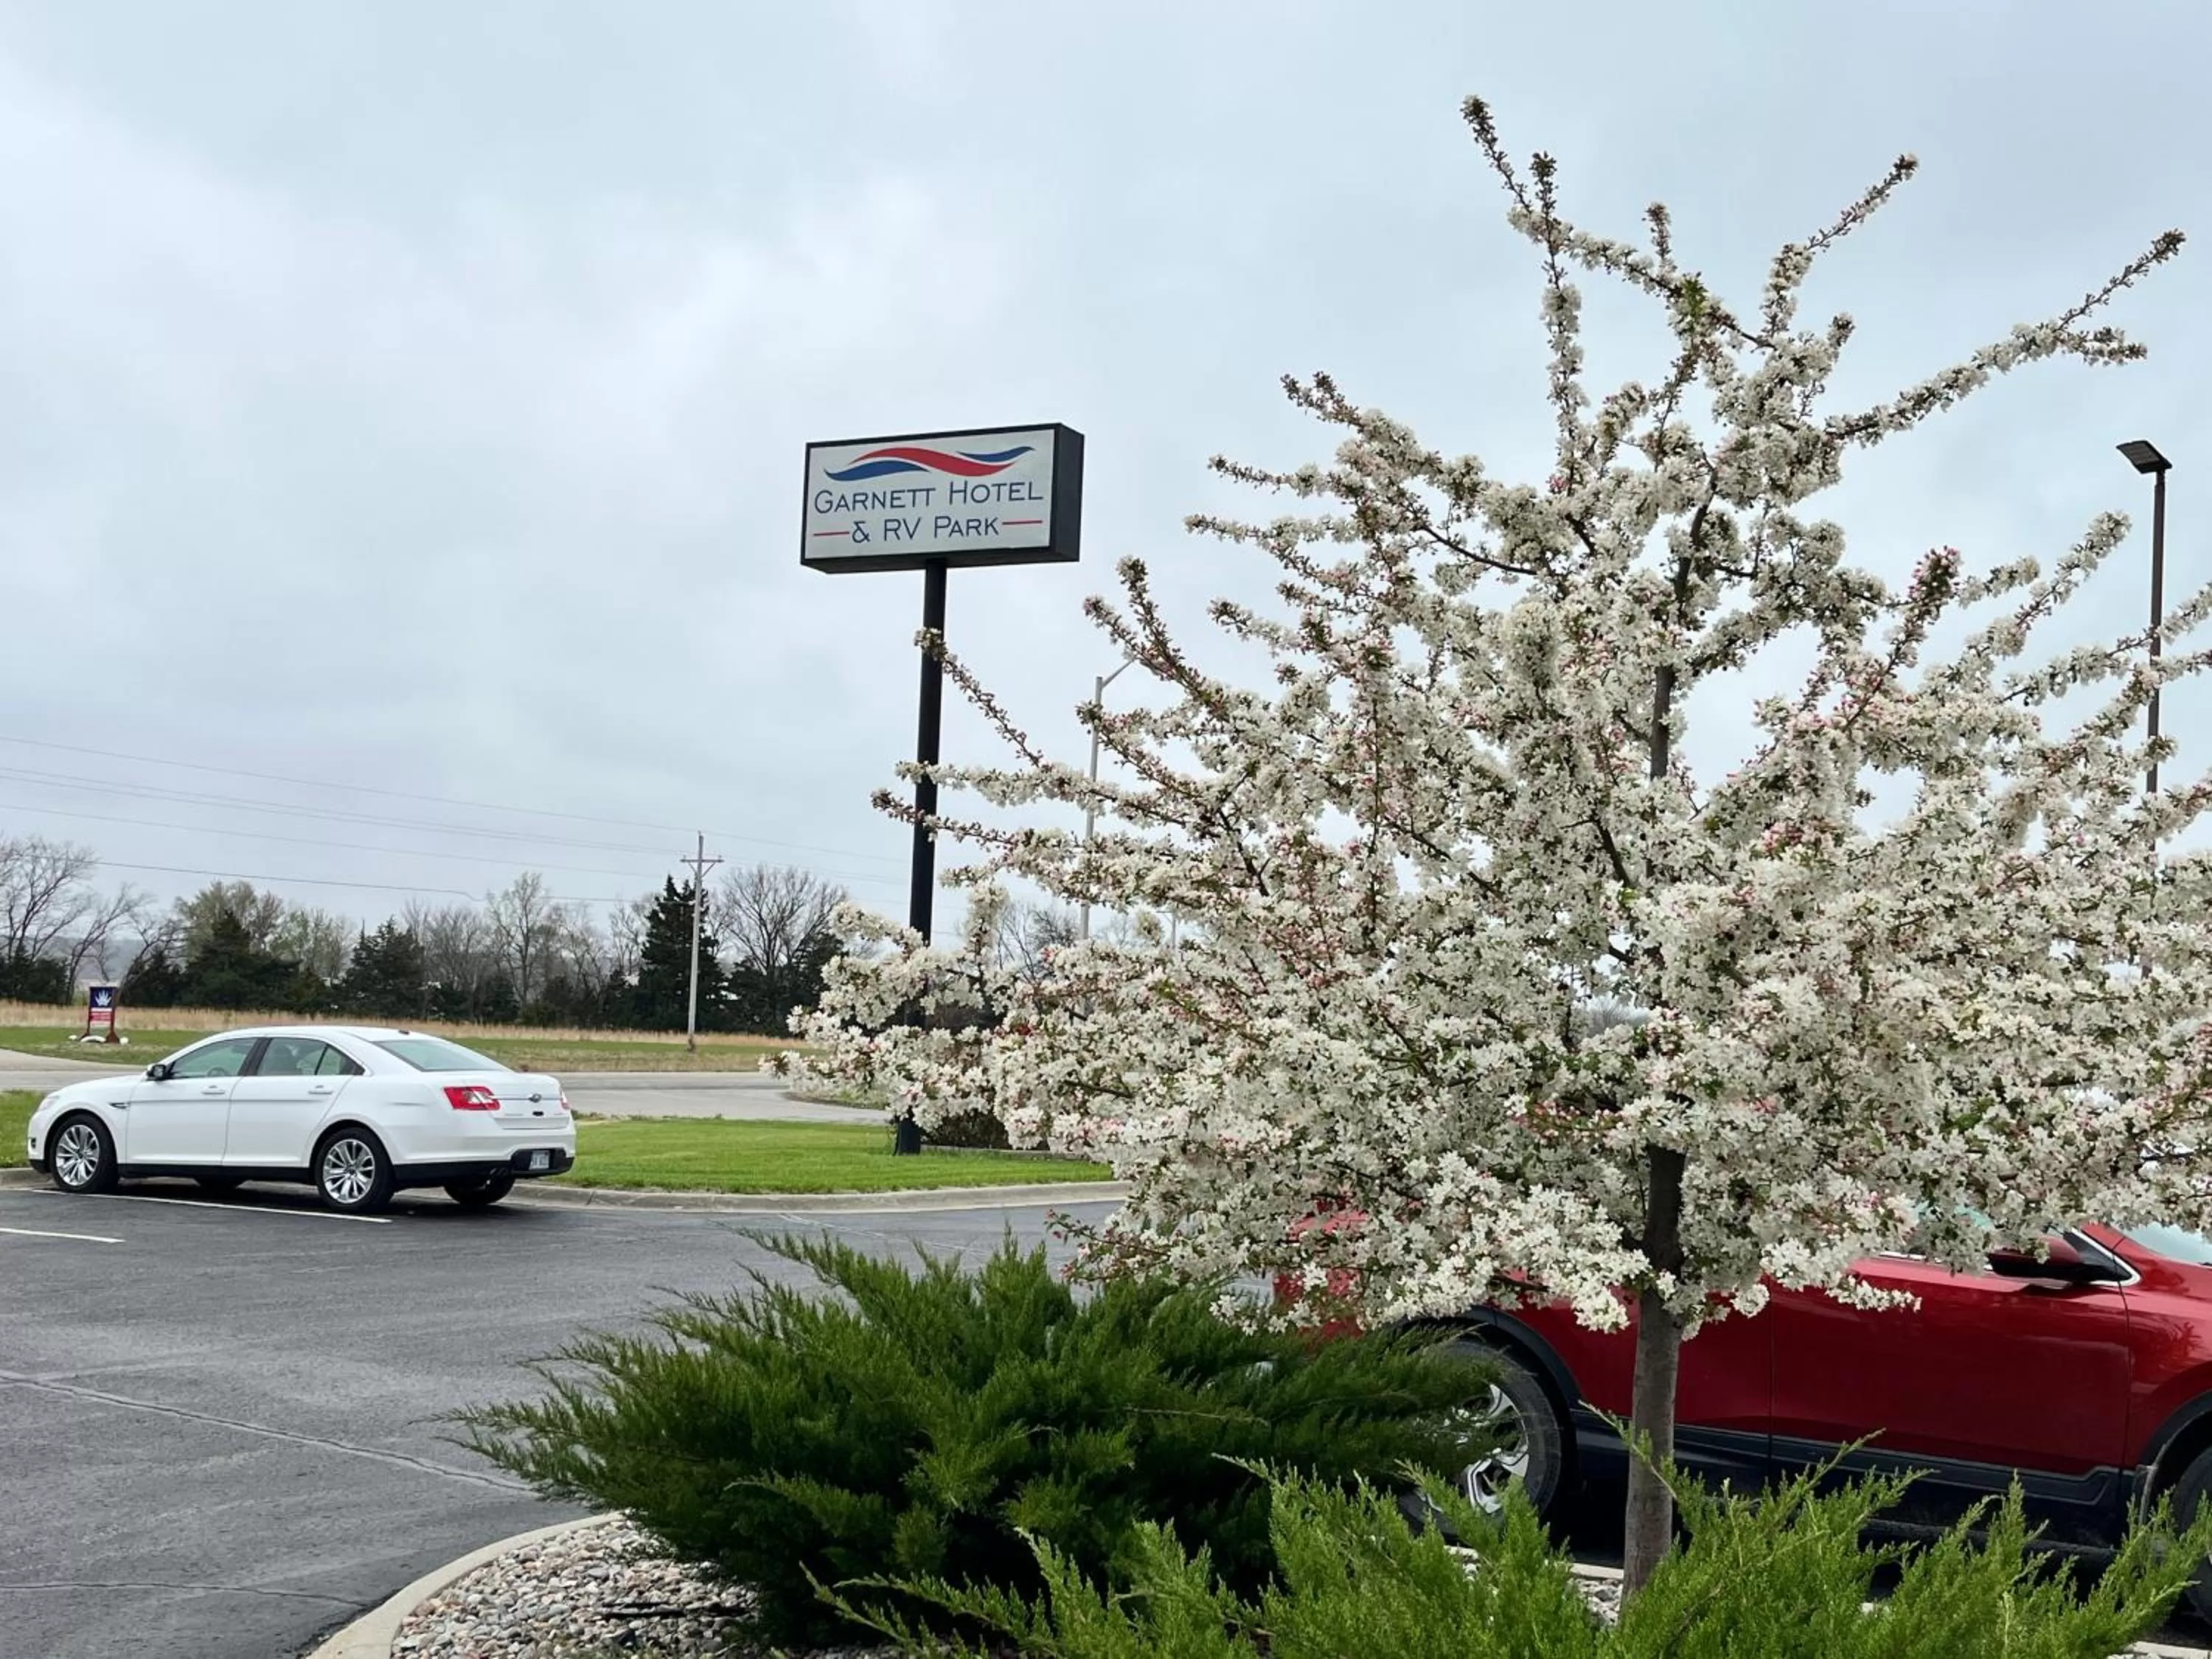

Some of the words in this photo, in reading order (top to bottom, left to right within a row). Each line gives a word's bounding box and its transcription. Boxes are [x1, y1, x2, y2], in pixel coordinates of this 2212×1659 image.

[814, 487, 936, 513] GARNETT
[950, 481, 1043, 504] HOTEL
[852, 521, 870, 543] &
[884, 518, 922, 541] RV
[934, 516, 999, 538] PARK
